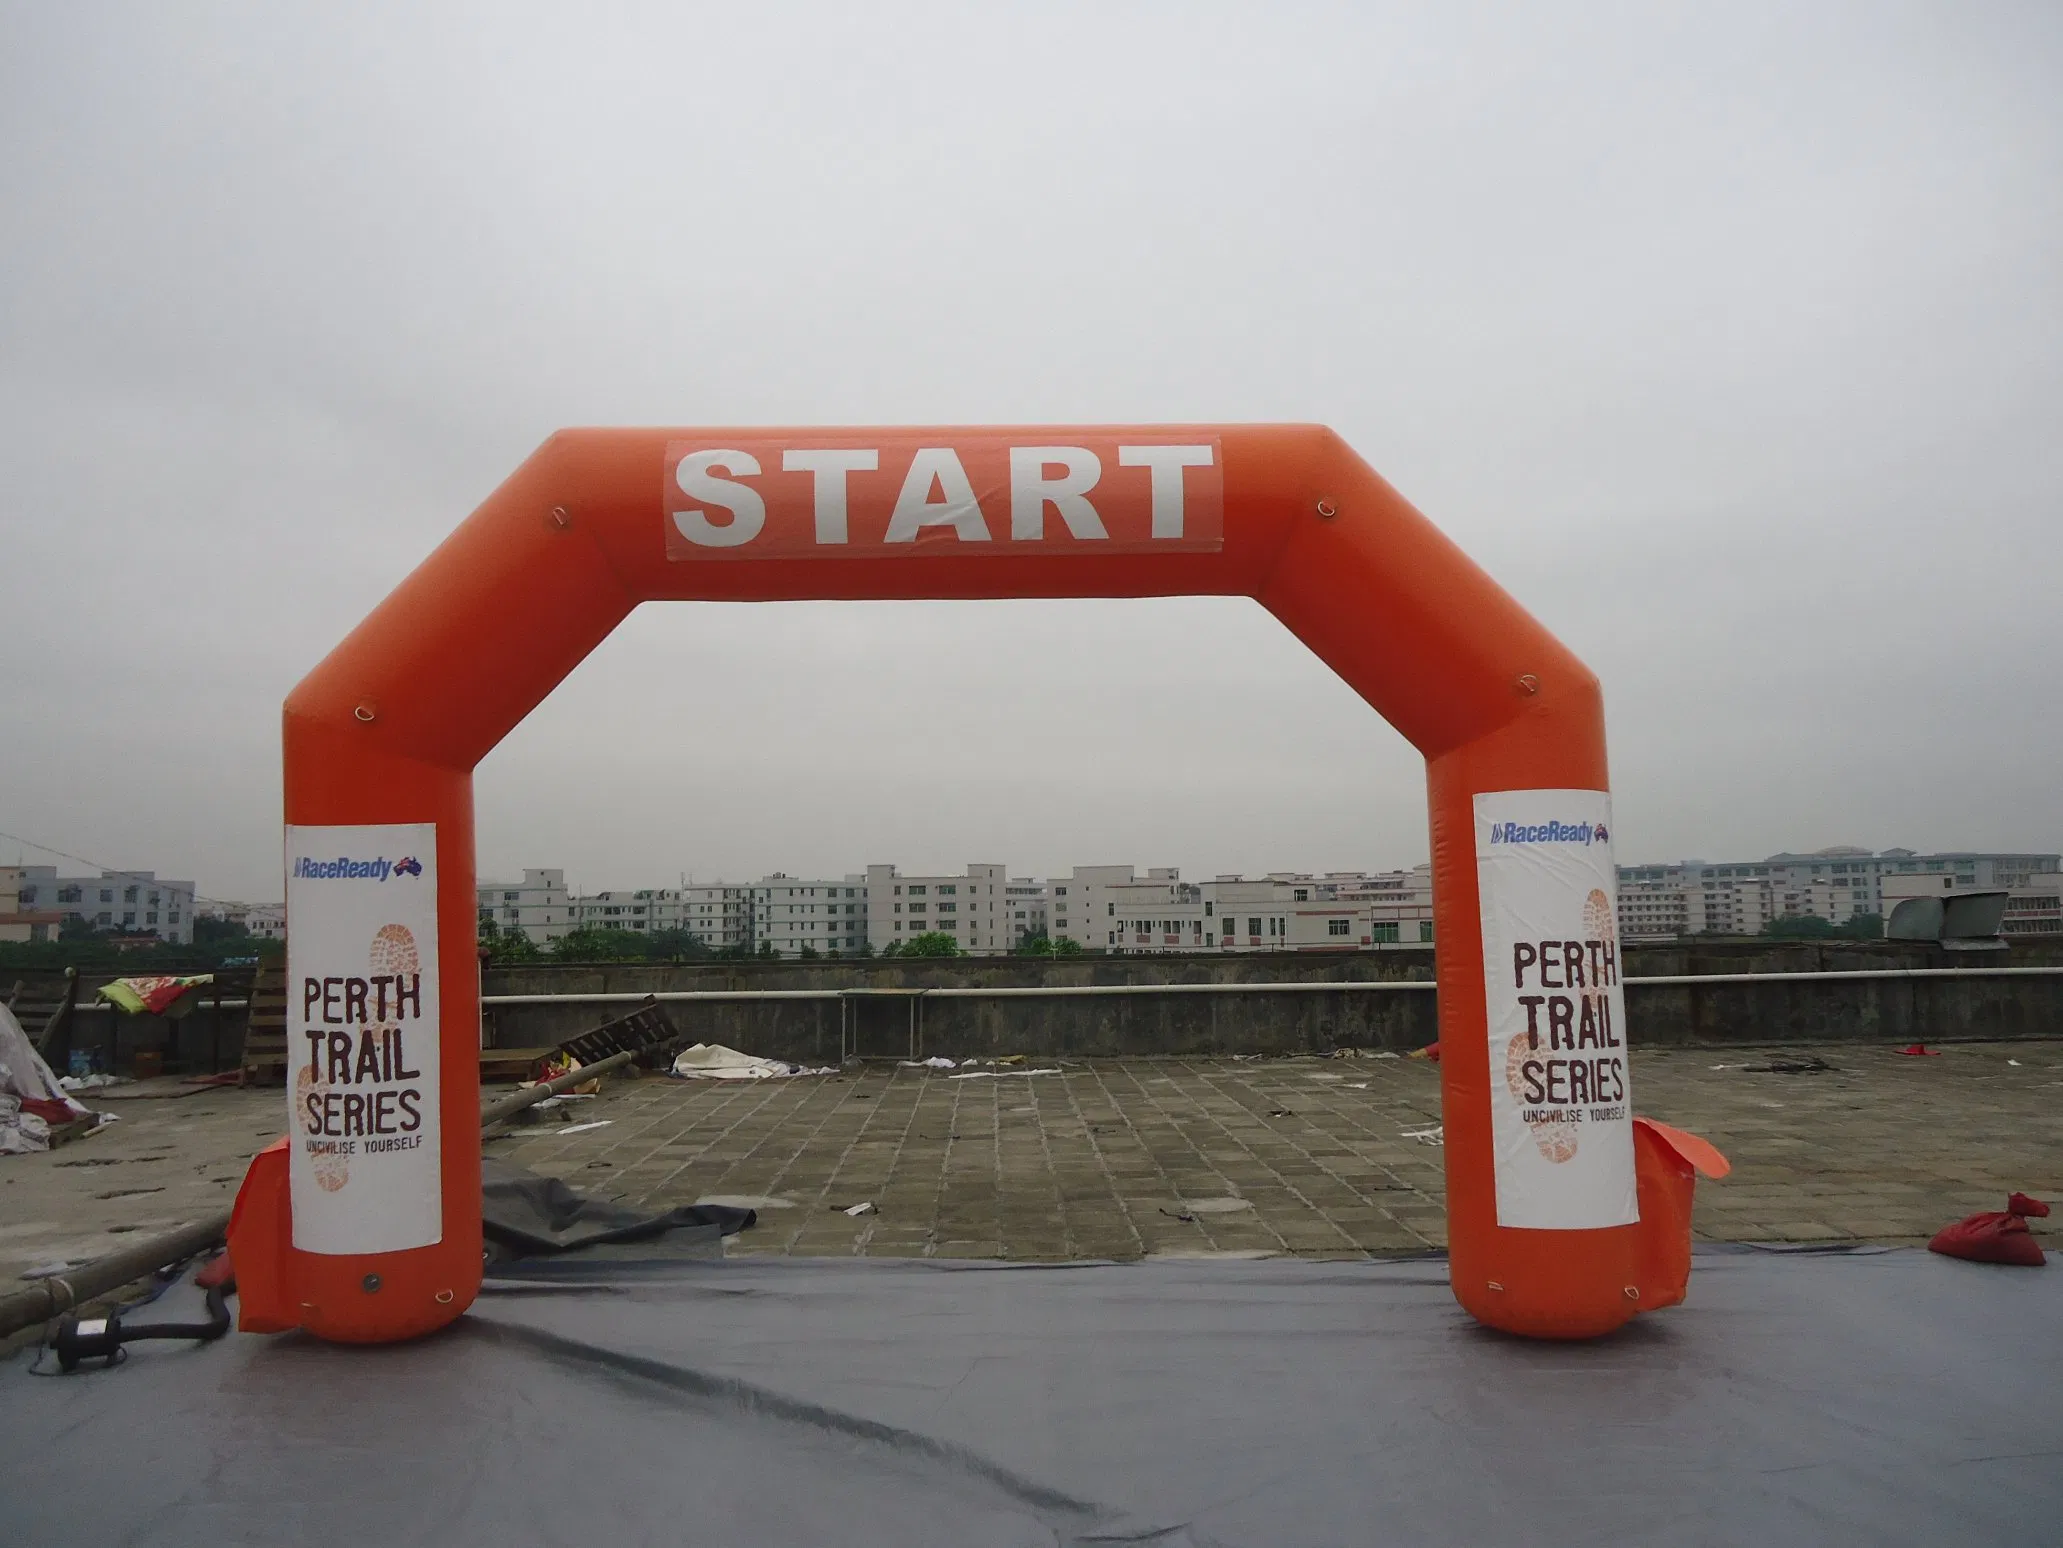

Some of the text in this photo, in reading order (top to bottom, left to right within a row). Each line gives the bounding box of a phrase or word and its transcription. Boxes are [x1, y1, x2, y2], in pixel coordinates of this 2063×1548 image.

[672, 444, 1214, 548] START
[1503, 820, 1594, 846] RaceReady
[301, 856, 393, 882] RaceReady
[1514, 940, 1617, 989] PERTH
[304, 973, 421, 1024] PERTH
[1518, 995, 1620, 1051] TRAIL
[305, 1029, 421, 1085] TRAIL
[1522, 1058, 1624, 1105] SERIES
[306, 1089, 421, 1137] SERIES
[1523, 1106, 1625, 1123] UNCIVILISE YOURSELF
[306, 1135, 422, 1154] UNCIVILISE YOURSELF
